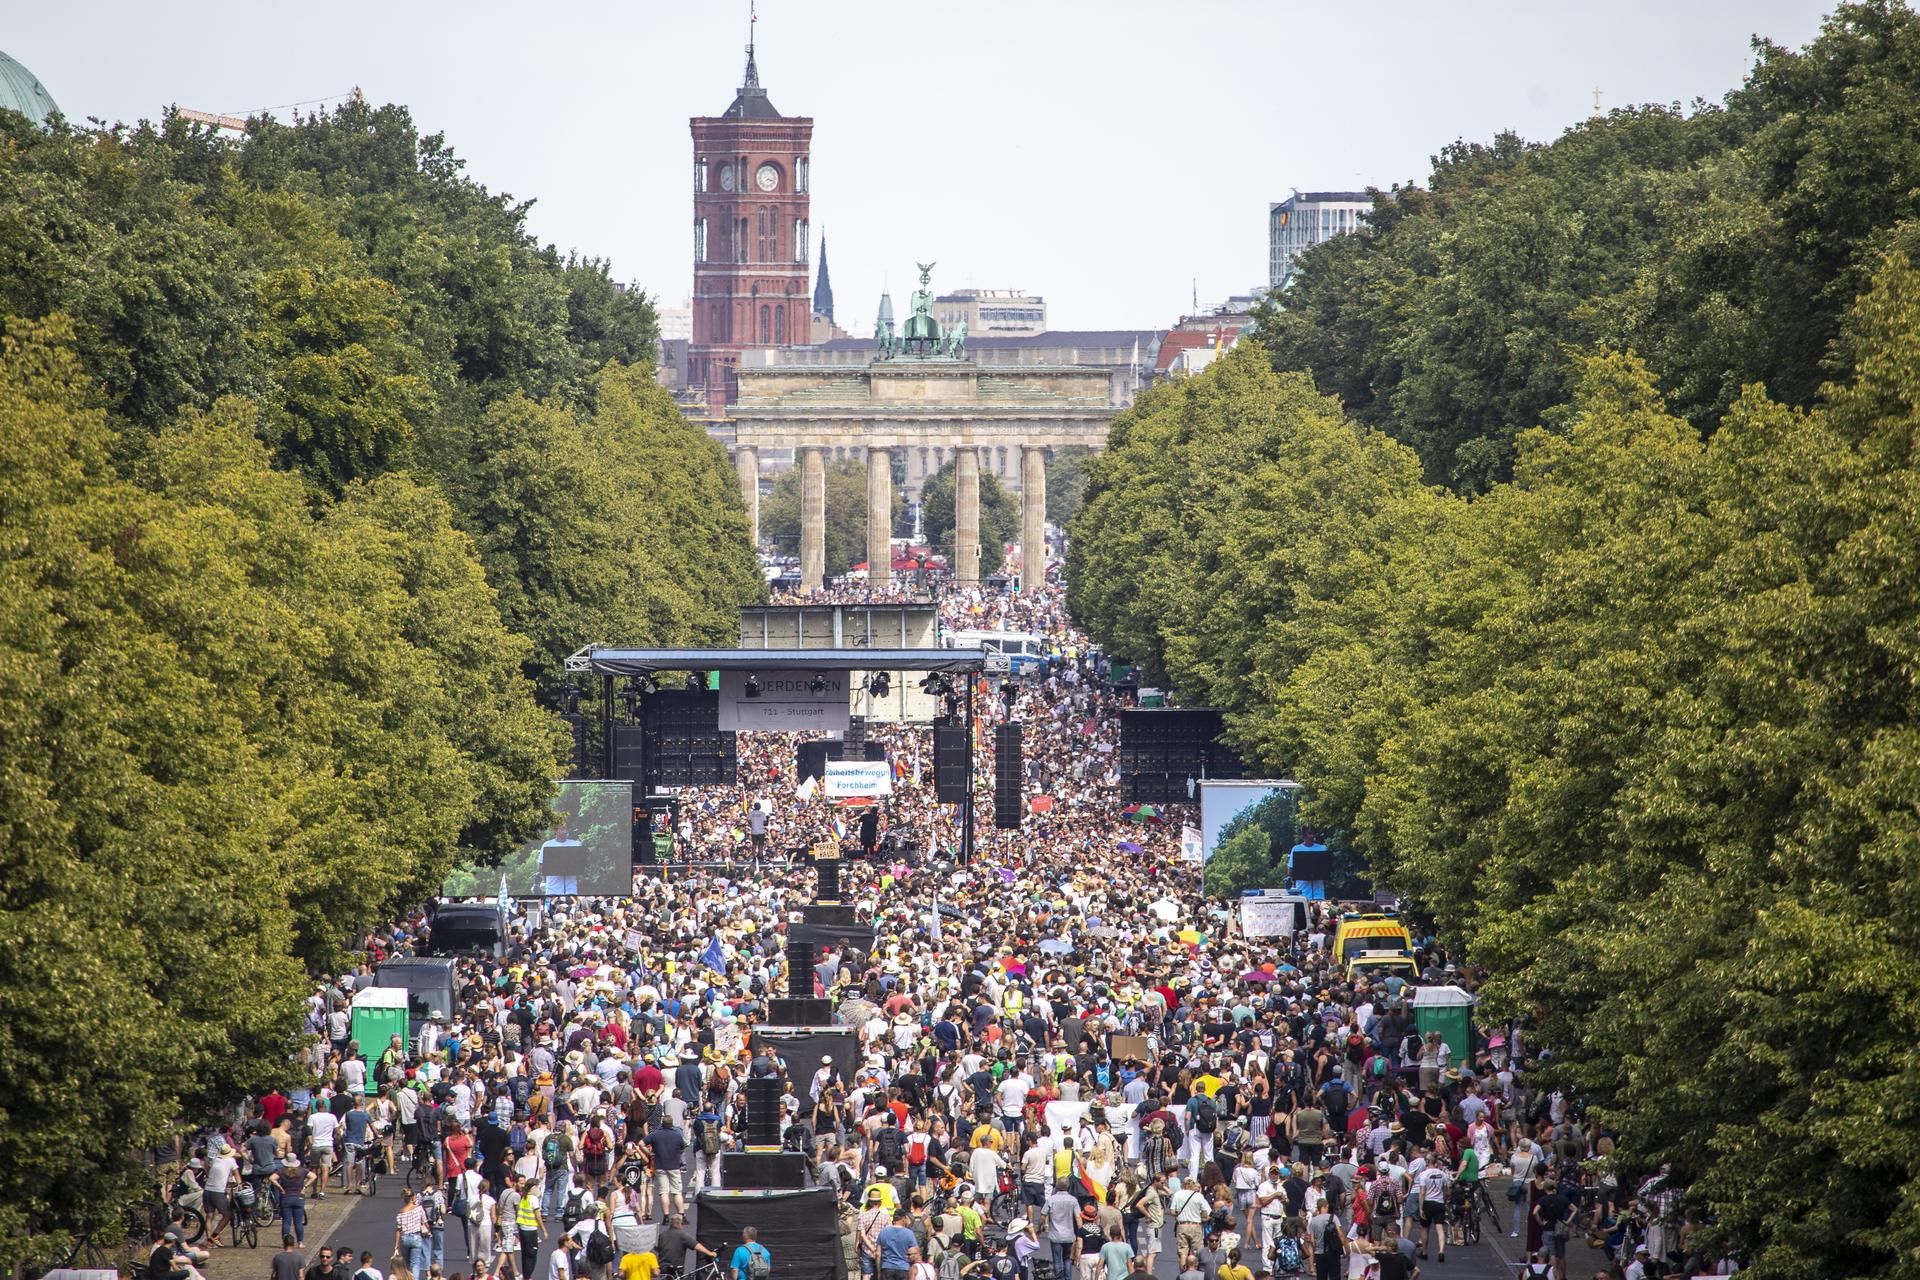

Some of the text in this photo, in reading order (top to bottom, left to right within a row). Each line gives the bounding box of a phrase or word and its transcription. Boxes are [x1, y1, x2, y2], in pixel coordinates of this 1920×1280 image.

[747, 680, 841, 692] UERDENEN
[763, 708, 779, 716] 711
[787, 708, 825, 717] Stuttgart
[837, 781, 878, 789] Forchheim
